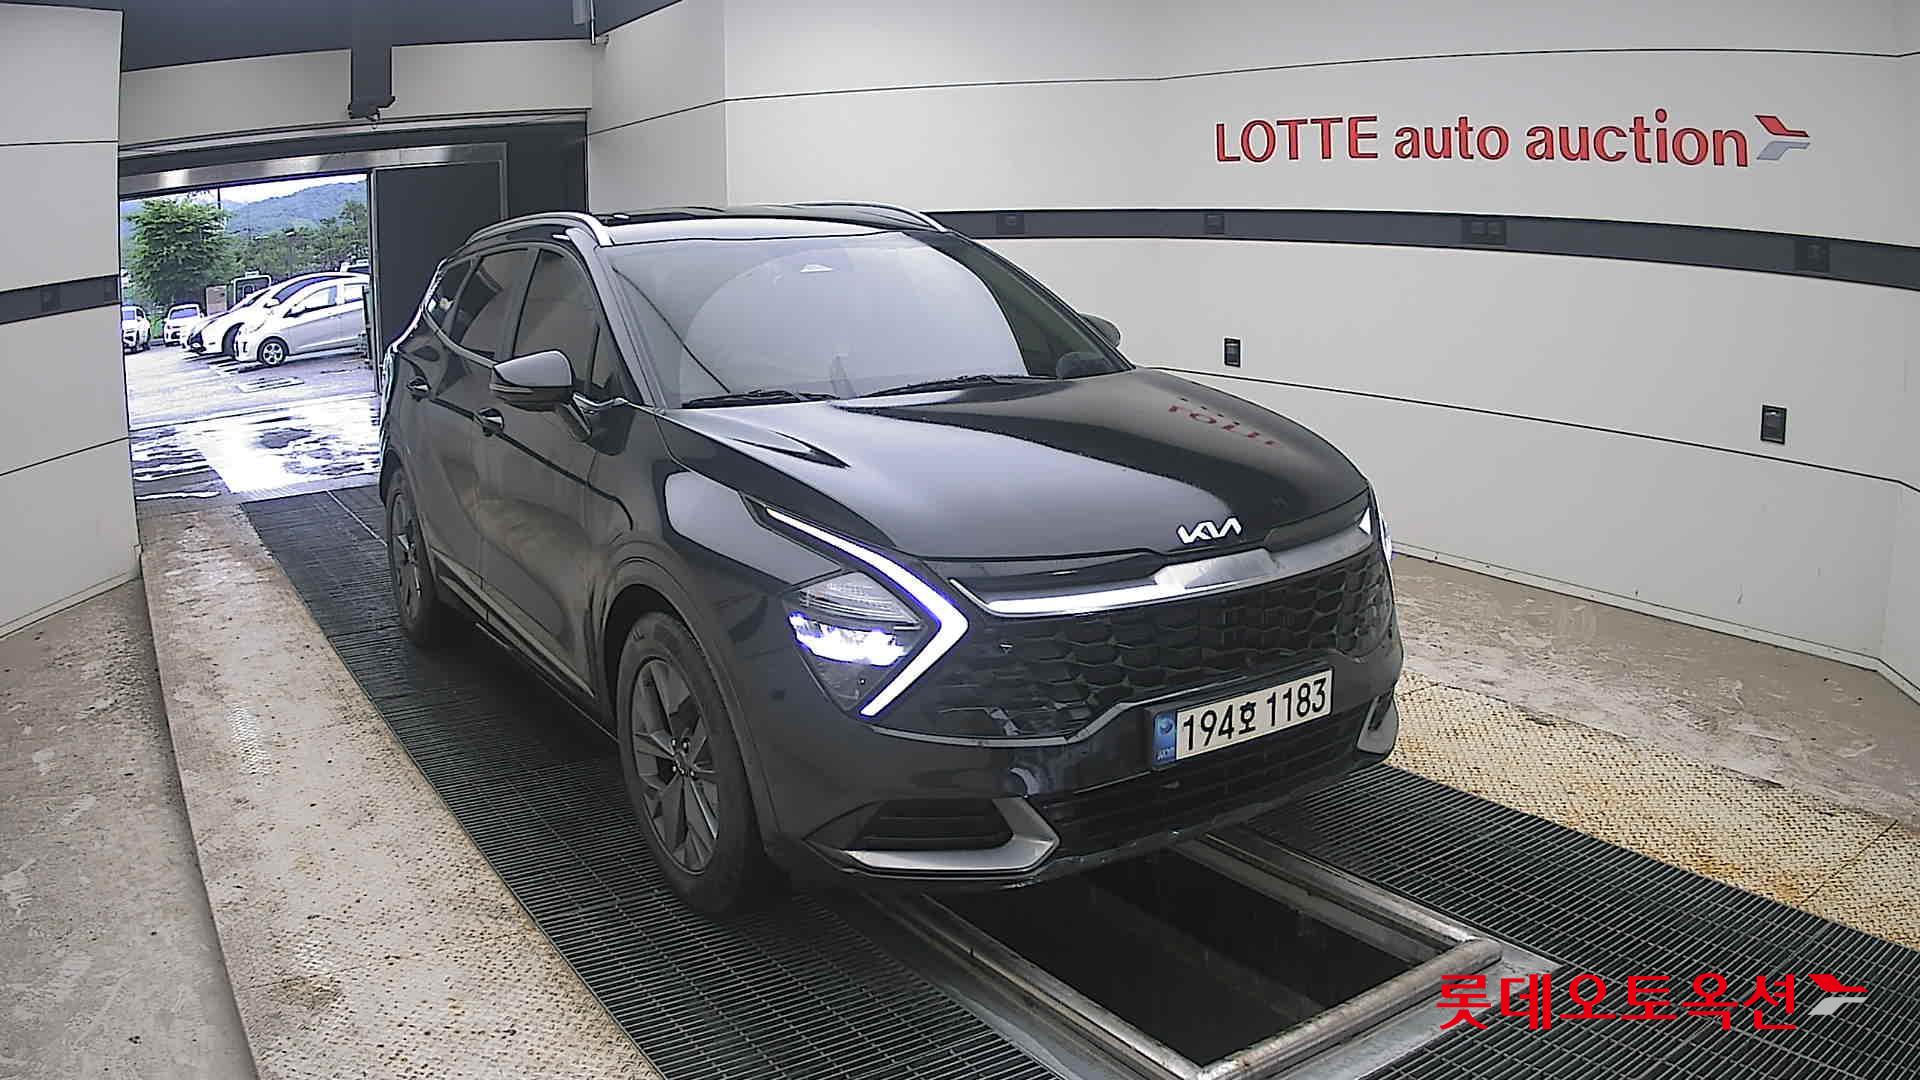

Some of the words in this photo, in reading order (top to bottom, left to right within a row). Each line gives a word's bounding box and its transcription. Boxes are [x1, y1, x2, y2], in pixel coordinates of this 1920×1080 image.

[1215, 115, 1379, 162] LOTTE
[1394, 116, 1510, 161] auto
[1525, 108, 1749, 168] auction
[1183, 702, 1257, 751] 194호
[1266, 677, 1327, 727] 1183
